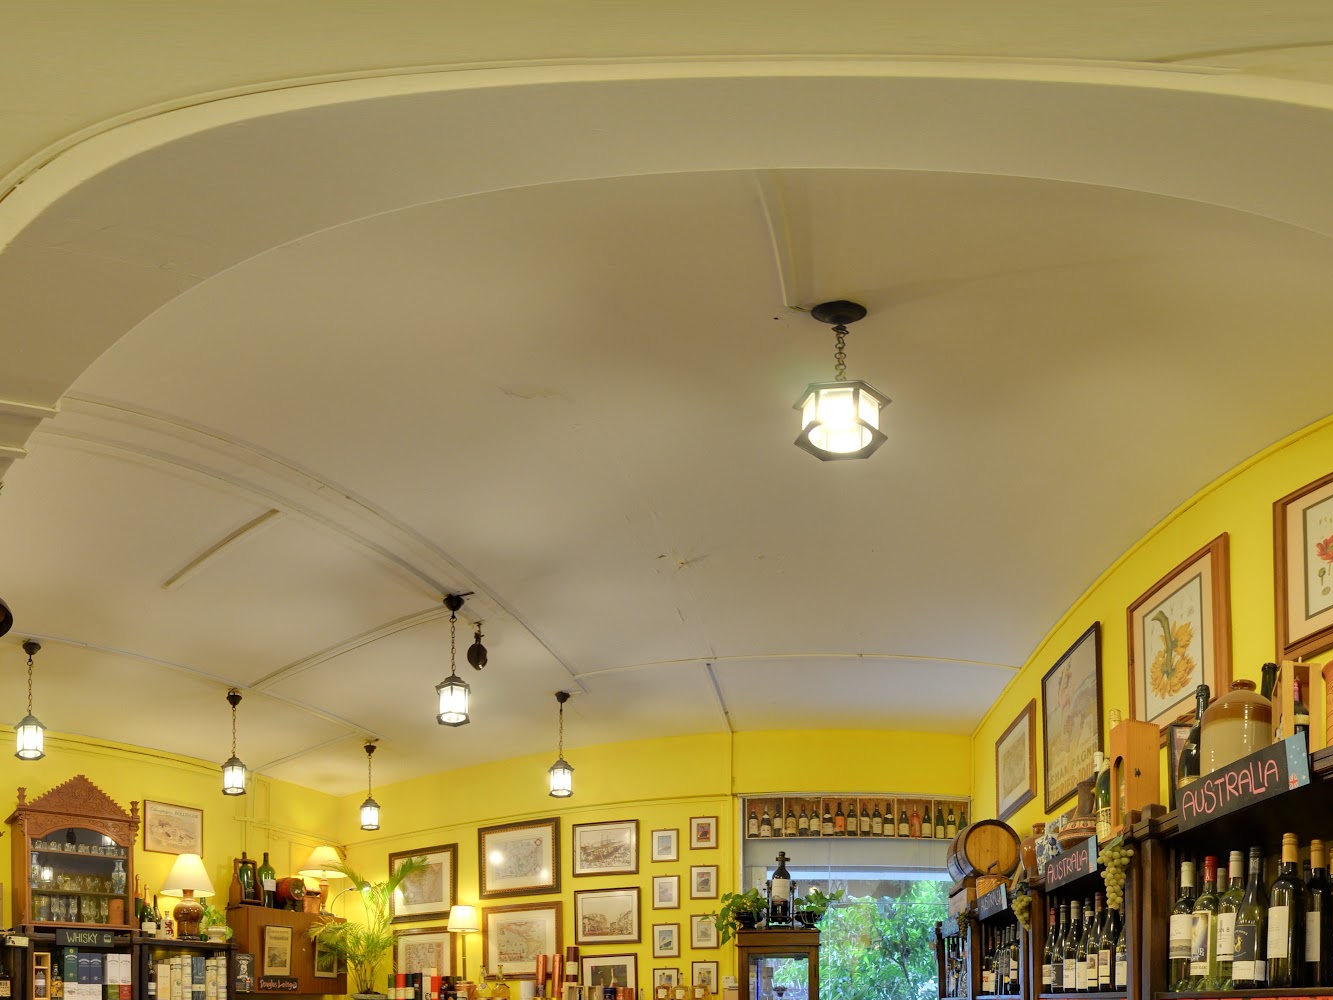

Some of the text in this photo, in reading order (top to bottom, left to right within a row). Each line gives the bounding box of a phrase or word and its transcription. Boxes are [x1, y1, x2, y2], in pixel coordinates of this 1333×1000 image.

[1181, 758, 1280, 822] AUSTRALIA
[1046, 848, 1088, 885] AUSTRALIA
[66, 932, 99, 944] WHISKY
